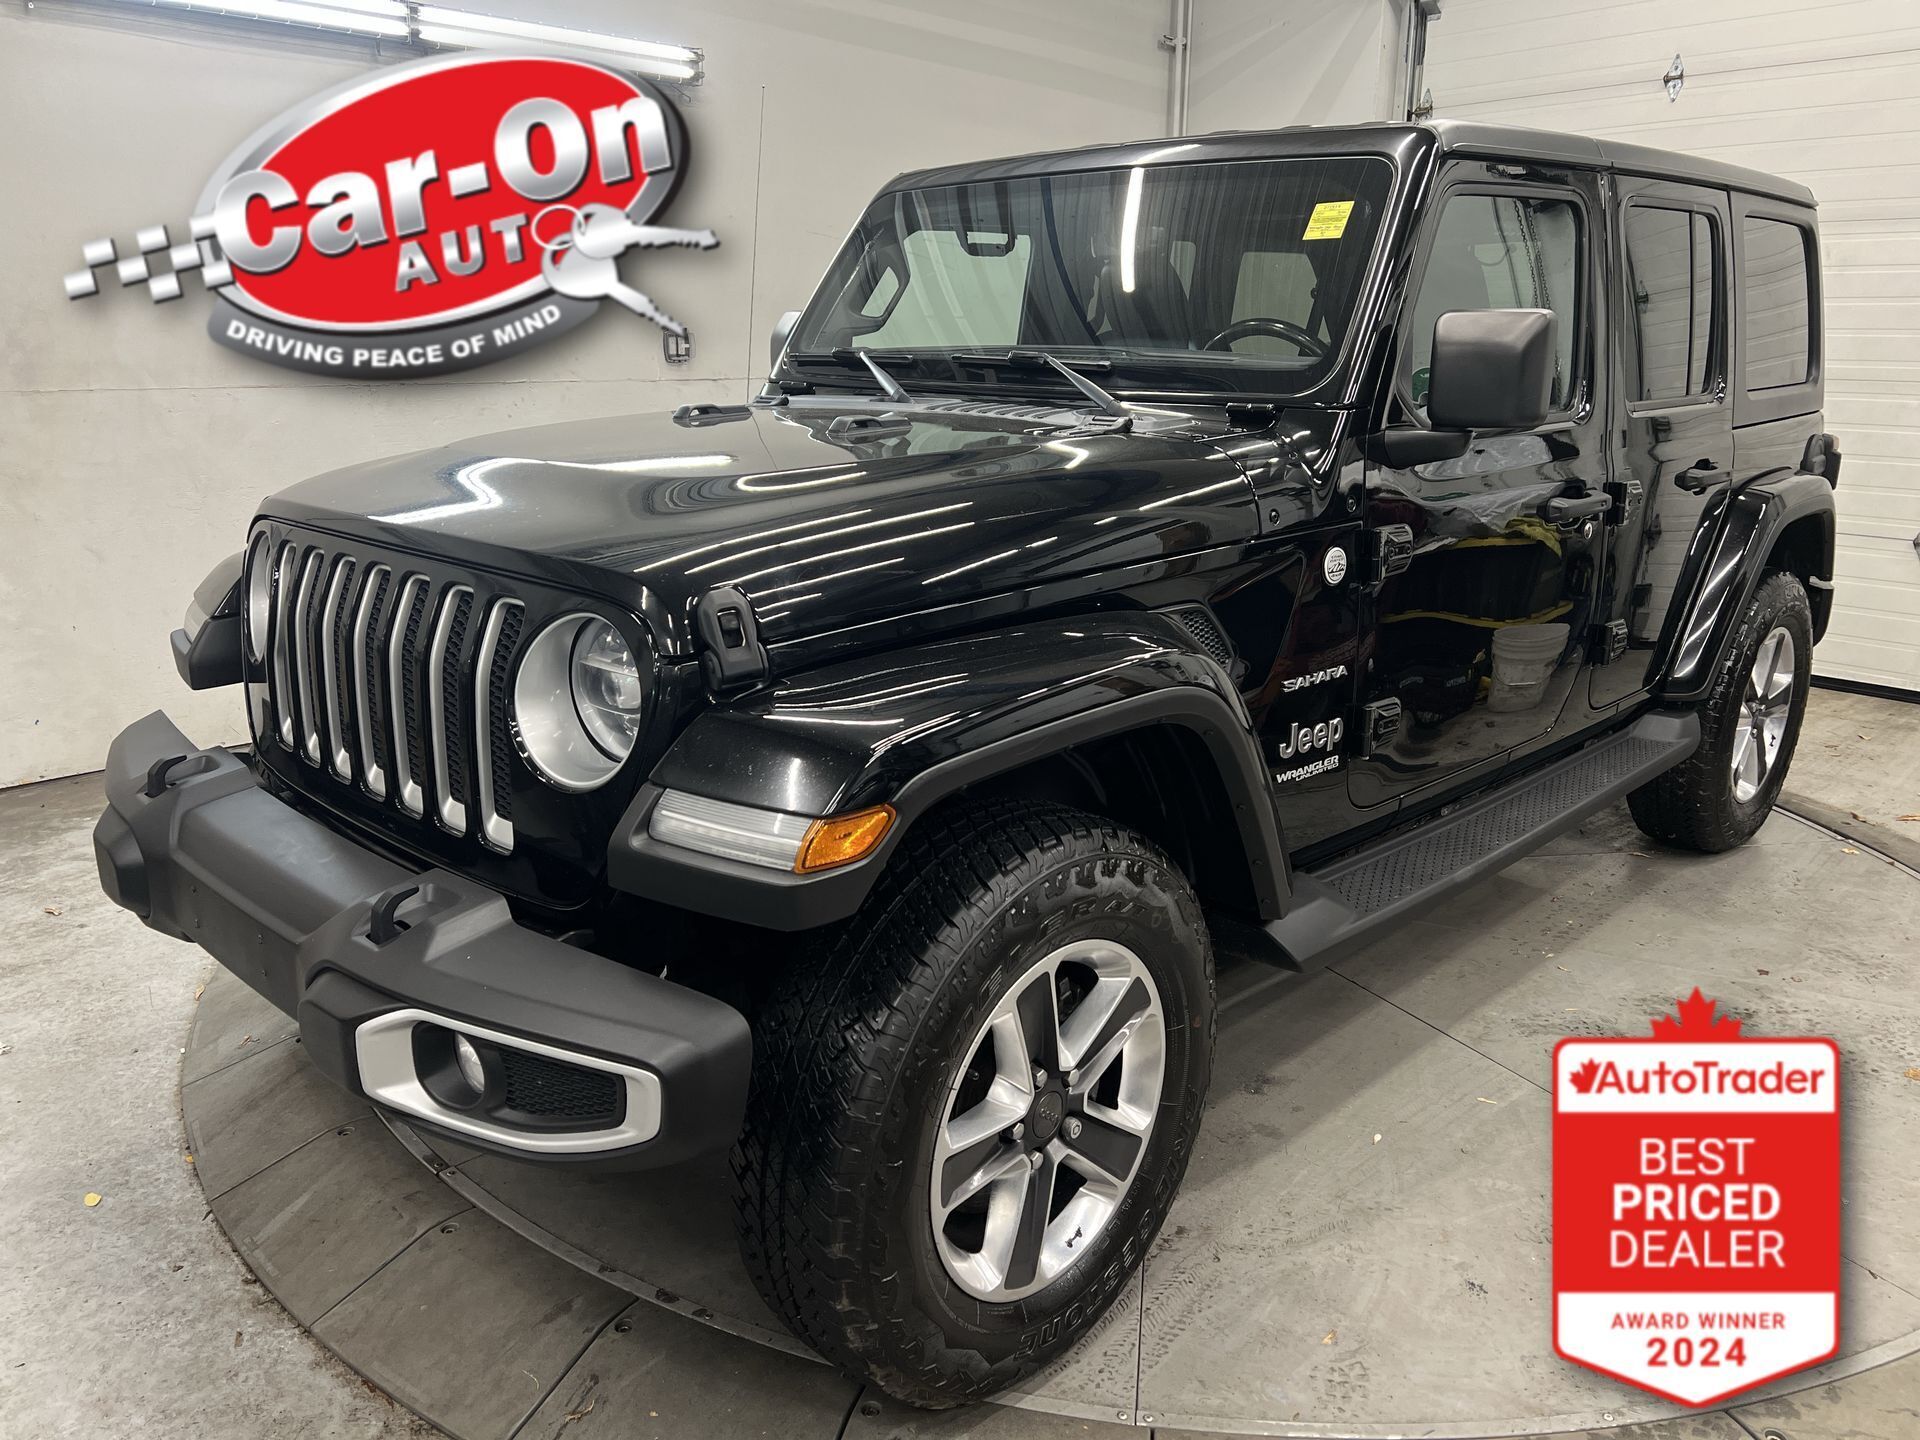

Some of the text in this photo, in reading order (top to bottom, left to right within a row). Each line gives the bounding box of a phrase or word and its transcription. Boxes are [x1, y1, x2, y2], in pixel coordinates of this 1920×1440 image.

[1282, 665, 1348, 692] SAHARA
[1279, 717, 1344, 759] Jeep
[1276, 755, 1339, 783] WRANGLER
[1296, 763, 1339, 781] UNLIMITED
